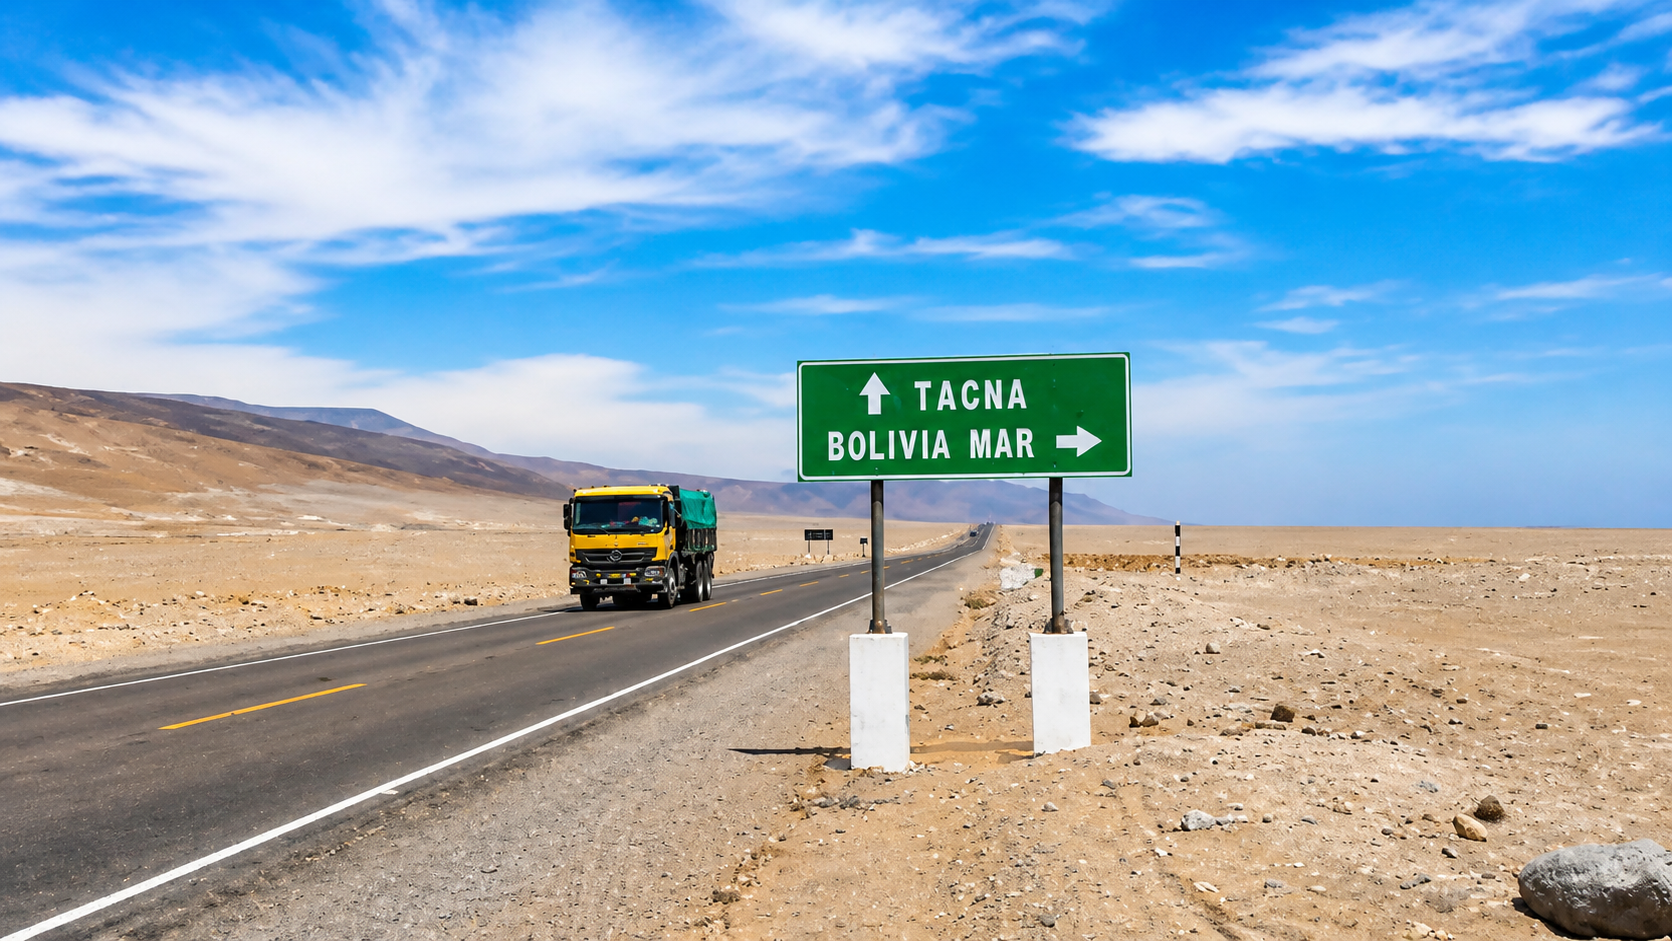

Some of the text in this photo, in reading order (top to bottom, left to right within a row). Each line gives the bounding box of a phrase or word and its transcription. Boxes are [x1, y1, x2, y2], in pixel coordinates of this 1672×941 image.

[914, 379, 1027, 411] TACNA
[827, 427, 1036, 461] BOLIVIA MAR
